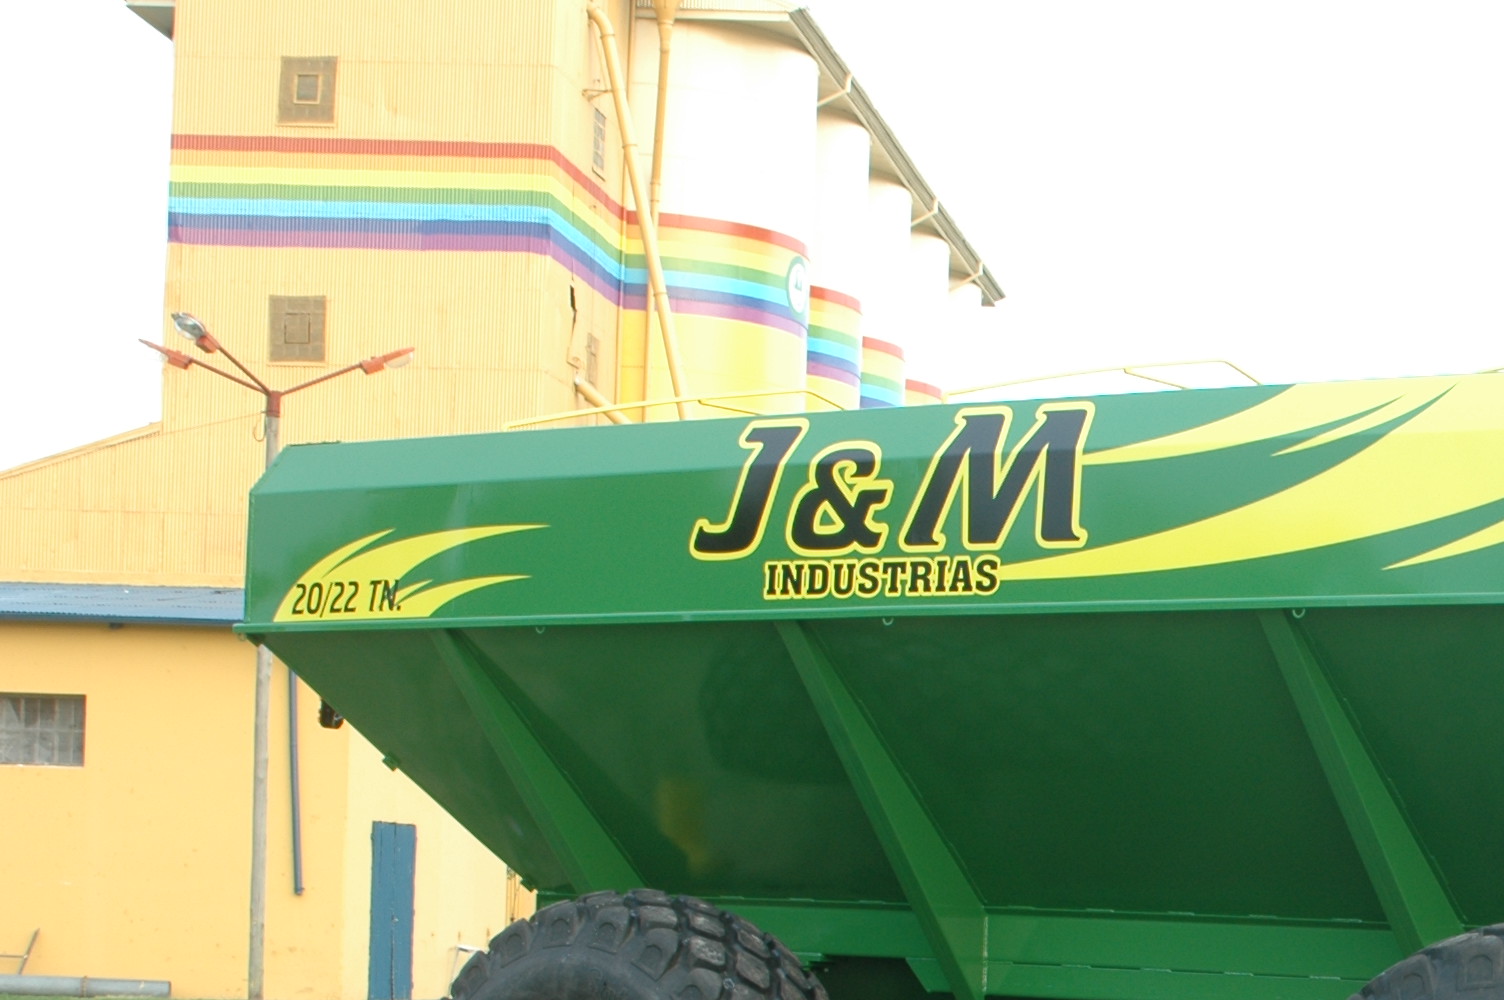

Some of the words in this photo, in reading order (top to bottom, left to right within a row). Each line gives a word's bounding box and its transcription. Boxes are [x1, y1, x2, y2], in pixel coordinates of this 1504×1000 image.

[690, 402, 1095, 561] J&M
[763, 555, 1003, 599] INDUSTRIAS
[291, 581, 360, 618] 20/22
